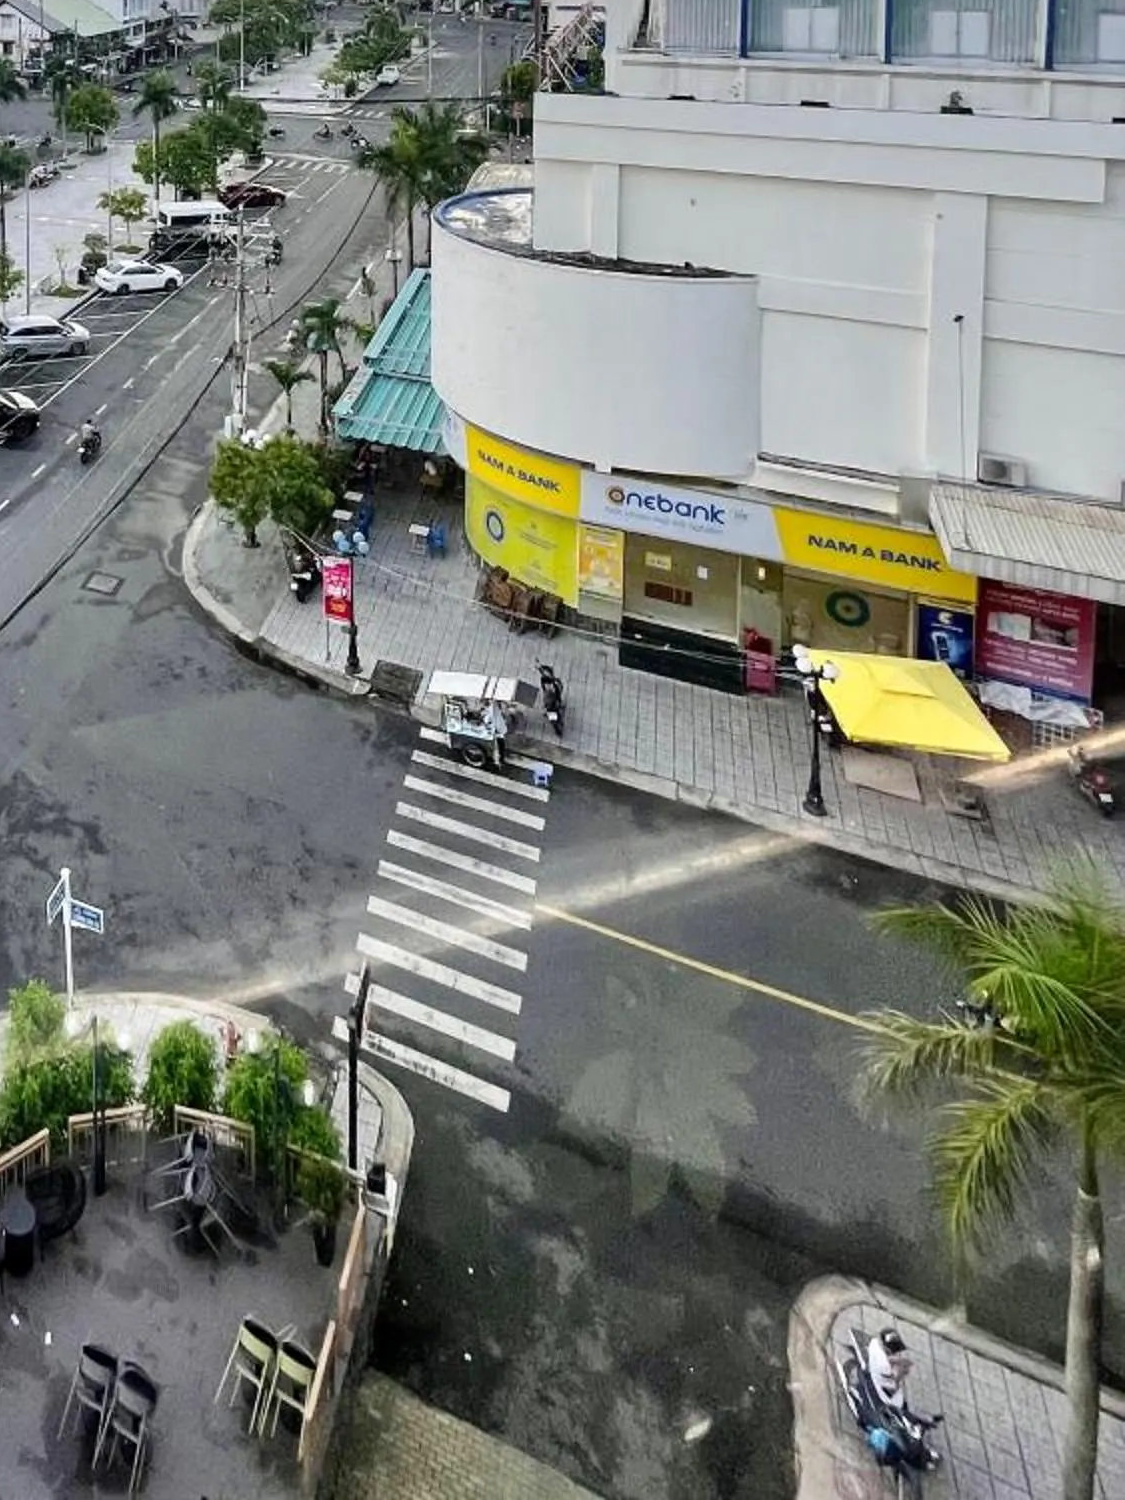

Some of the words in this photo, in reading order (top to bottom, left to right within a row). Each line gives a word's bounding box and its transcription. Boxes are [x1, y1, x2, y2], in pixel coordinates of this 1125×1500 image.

[477, 449, 504, 472] NAM
[507, 465, 515, 477] A
[518, 470, 561, 493] BANK
[807, 535, 858, 555] NAM
[862, 547, 876, 559] A
[880, 549, 943, 573] BANK
